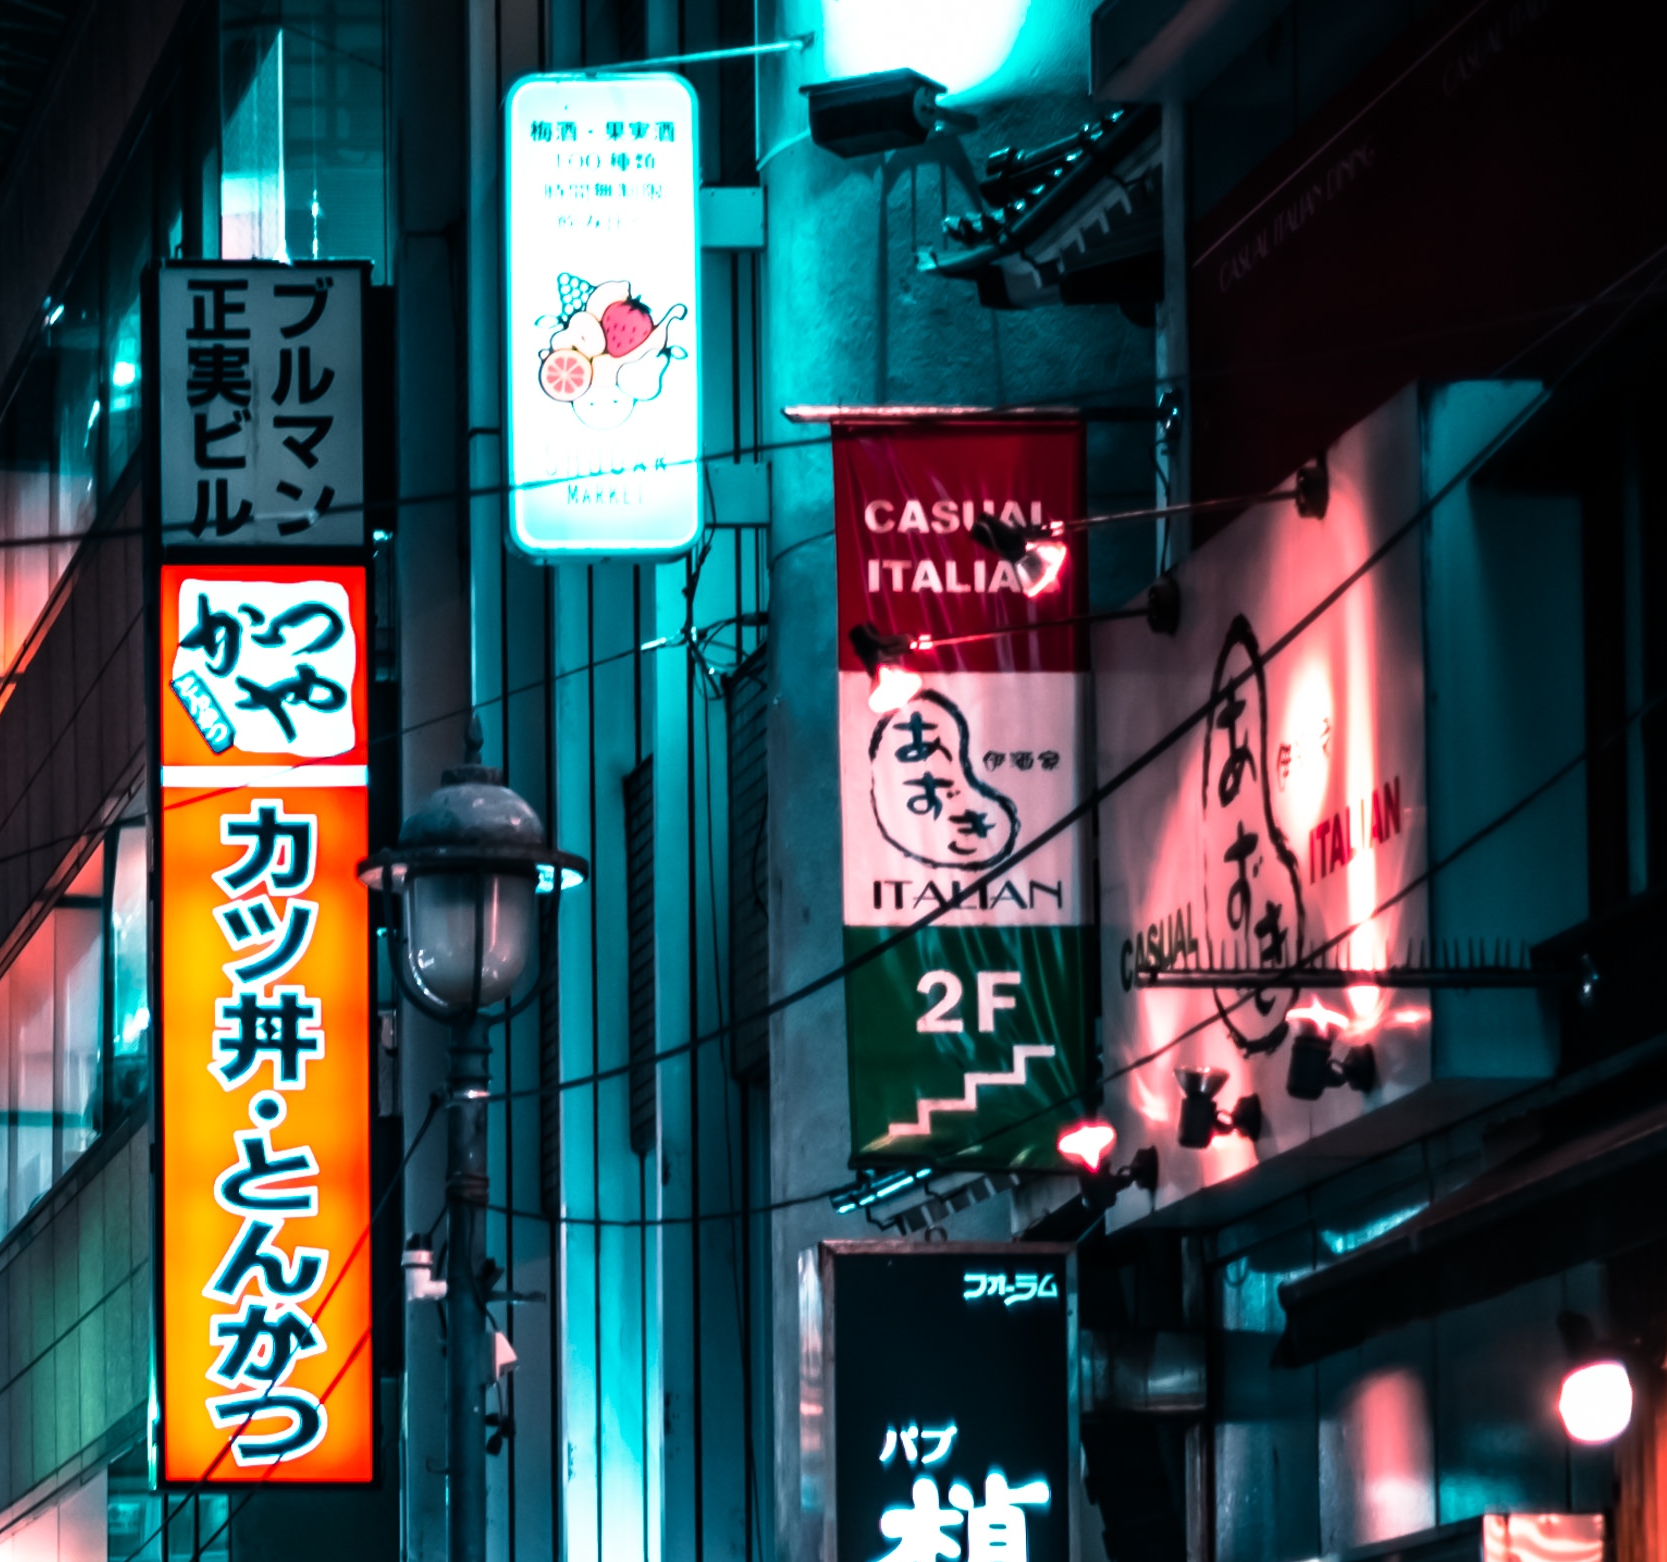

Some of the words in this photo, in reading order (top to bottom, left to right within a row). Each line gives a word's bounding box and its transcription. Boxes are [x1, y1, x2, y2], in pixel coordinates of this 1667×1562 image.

[186, 278, 253, 538] 正実ビル
[271, 276, 335, 537] ブルマン
[179, 592, 348, 744] かつや
[894, 711, 998, 858] あずき
[1308, 774, 1404, 885] ITALIAN
[872, 879, 1066, 914] ITALIAN
[913, 969, 1023, 1035] 2F
[878, 1421, 959, 1465] パブ
